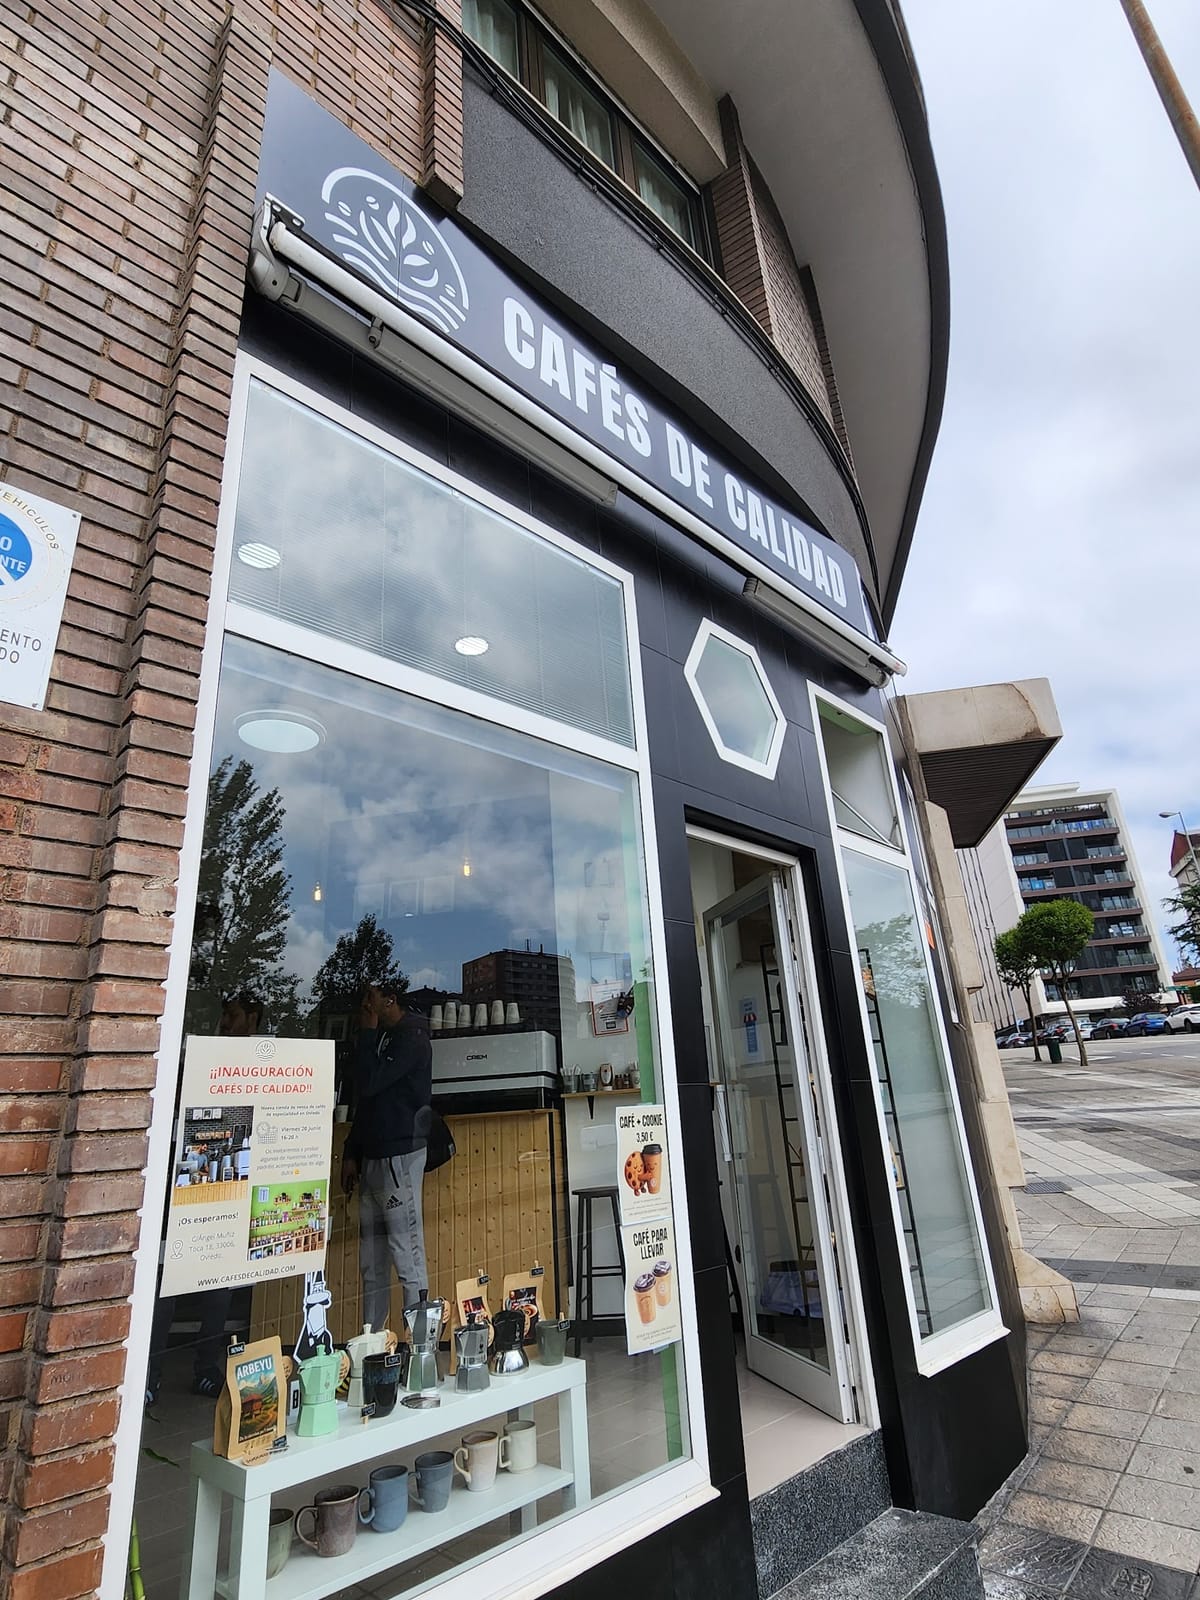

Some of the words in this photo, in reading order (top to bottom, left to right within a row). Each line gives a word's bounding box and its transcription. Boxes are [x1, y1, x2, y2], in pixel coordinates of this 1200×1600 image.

[503, 297, 652, 457] CAFÉS
[665, 422, 714, 509] DE
[724, 472, 847, 608] CALIDAD
[0, 488, 59, 550] EHICULOS
[245, 1084, 259, 1094] DE
[262, 1084, 312, 1094] CALIDAD!!
[619, 1113, 635, 1129] CAFÉ
[642, 1114, 663, 1128] COOKIE
[193, 1212, 239, 1225] esperamos!
[633, 1228, 649, 1247] CAFÉ
[651, 1227, 668, 1243] PARA
[641, 1242, 664, 1260] LLEVAR
[197, 1264, 297, 1287] WWW.CAFESDECALIDAD.COM
[236, 1356, 273, 1381] ARBEYU
